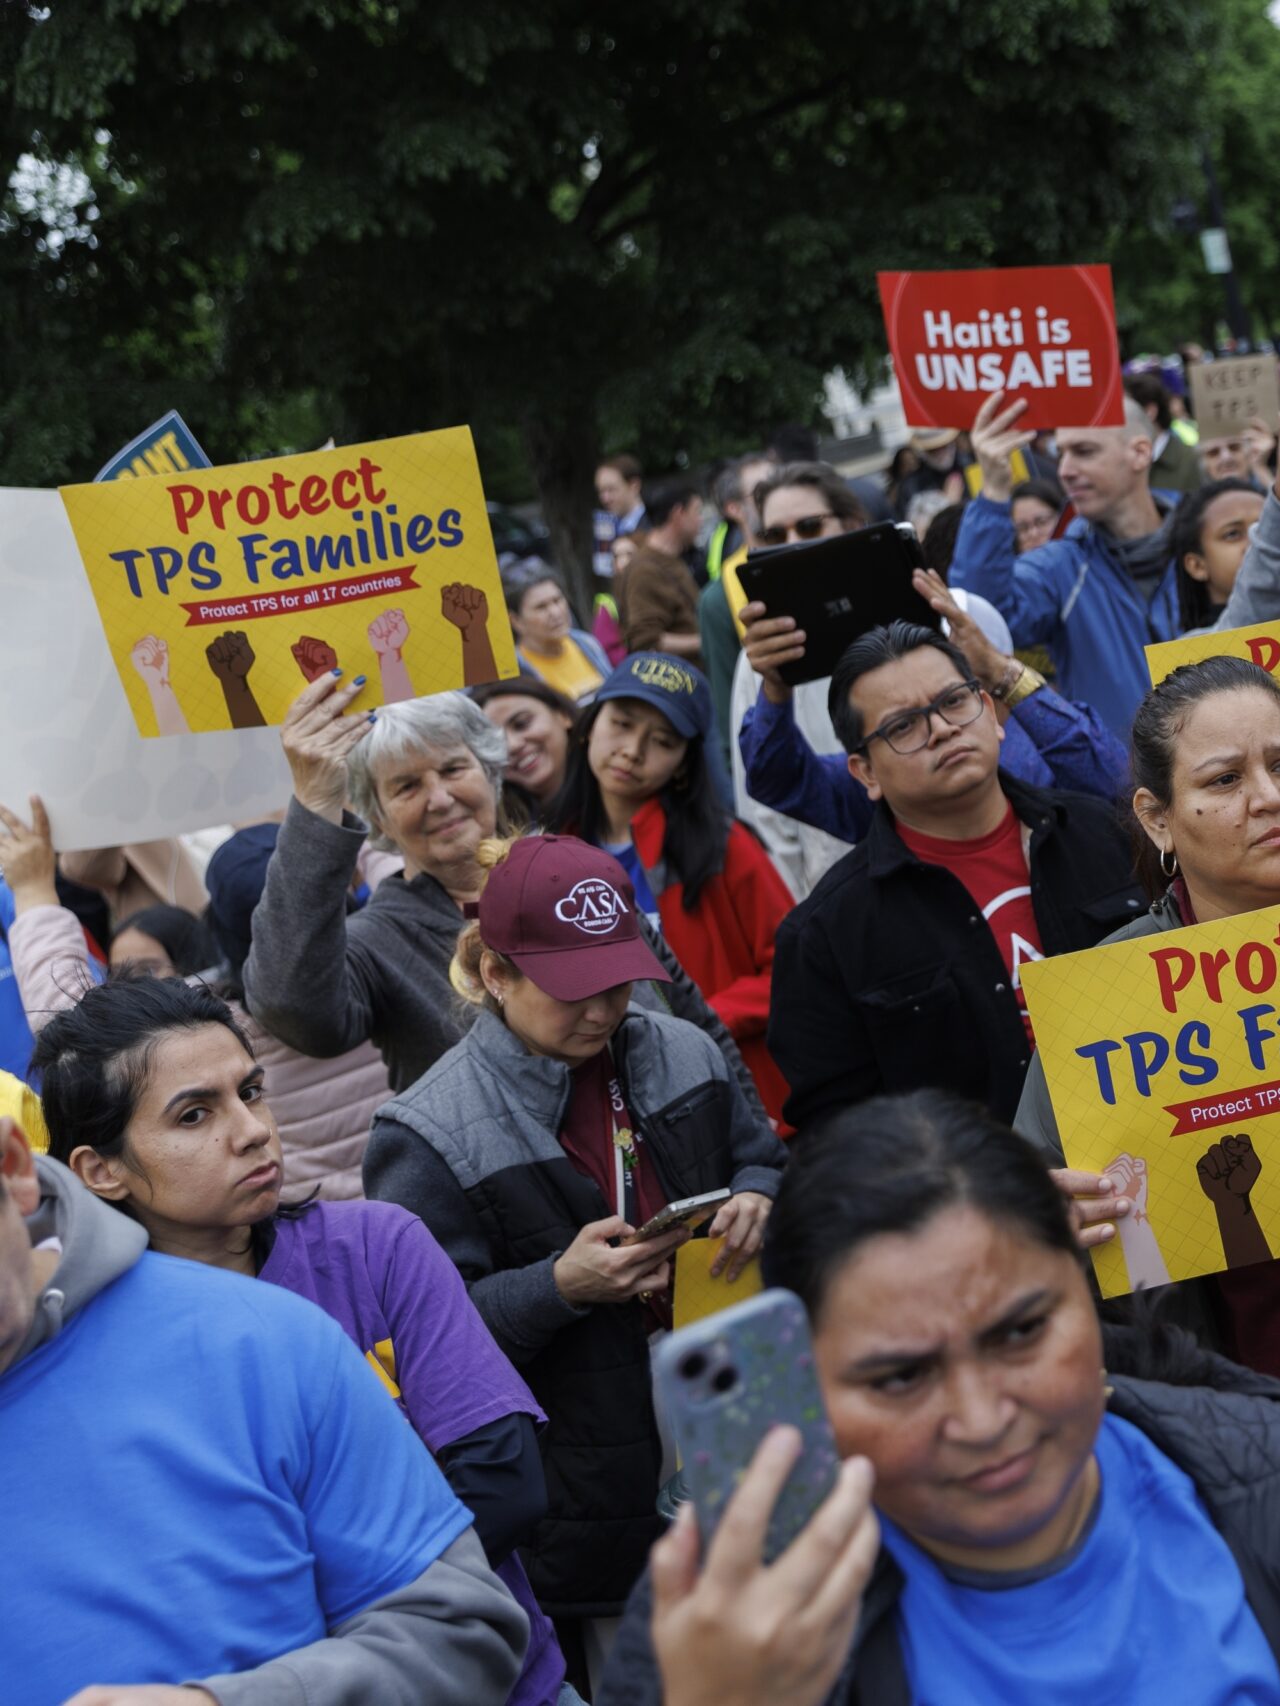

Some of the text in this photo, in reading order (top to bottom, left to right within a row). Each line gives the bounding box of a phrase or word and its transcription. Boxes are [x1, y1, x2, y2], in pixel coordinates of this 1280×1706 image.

[923, 305, 1072, 348] Haiti is
[914, 348, 1093, 391] UNSAFE
[165, 457, 387, 535] Protect
[108, 503, 464, 598] TPS Families
[199, 575, 402, 619] Protect TPS for all 17 countries
[554, 890, 630, 922] CASA
[1074, 1020, 1219, 1105] TPS
[1190, 1096, 1253, 1123] Protect
